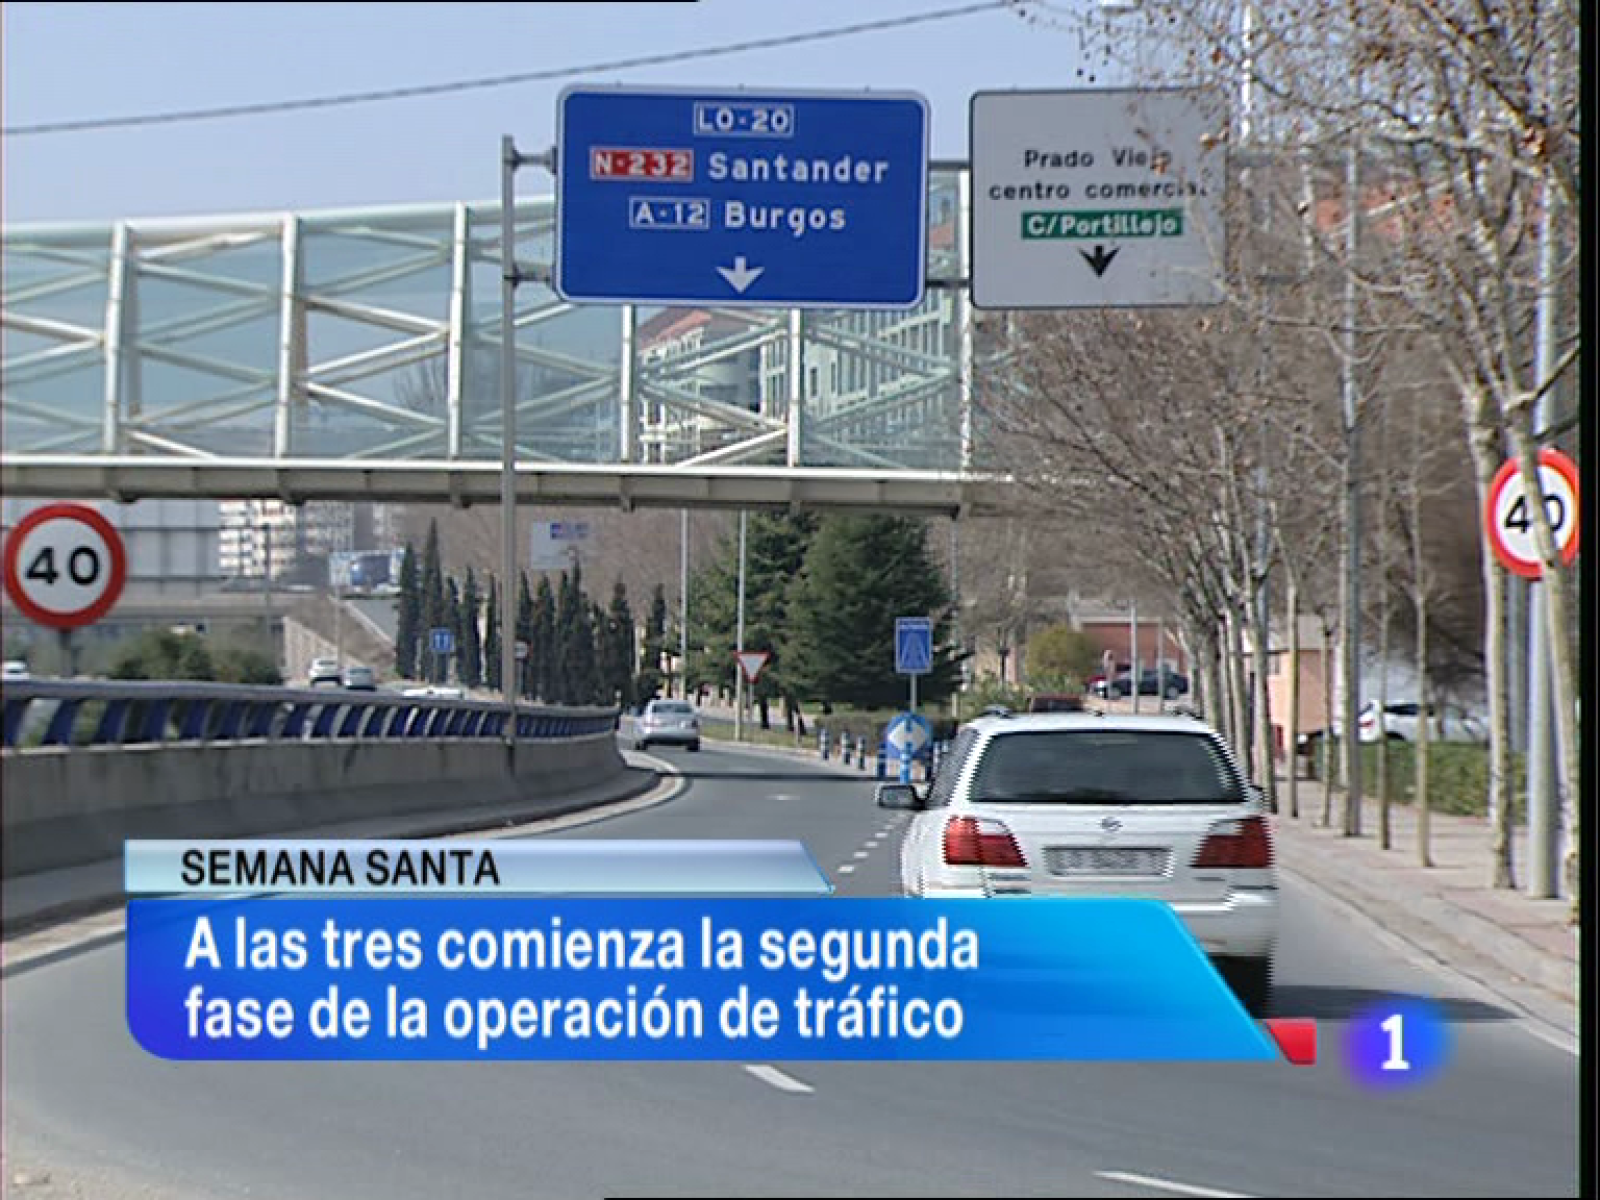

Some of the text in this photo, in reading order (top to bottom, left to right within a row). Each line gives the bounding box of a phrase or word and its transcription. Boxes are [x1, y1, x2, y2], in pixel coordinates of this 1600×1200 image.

[707, 151, 890, 183] Santander
[1023, 149, 1095, 168] Prado
[988, 181, 1071, 201] centro
[723, 200, 847, 237] Burgos
[1504, 494, 1566, 534] 40
[25, 545, 100, 587] 40
